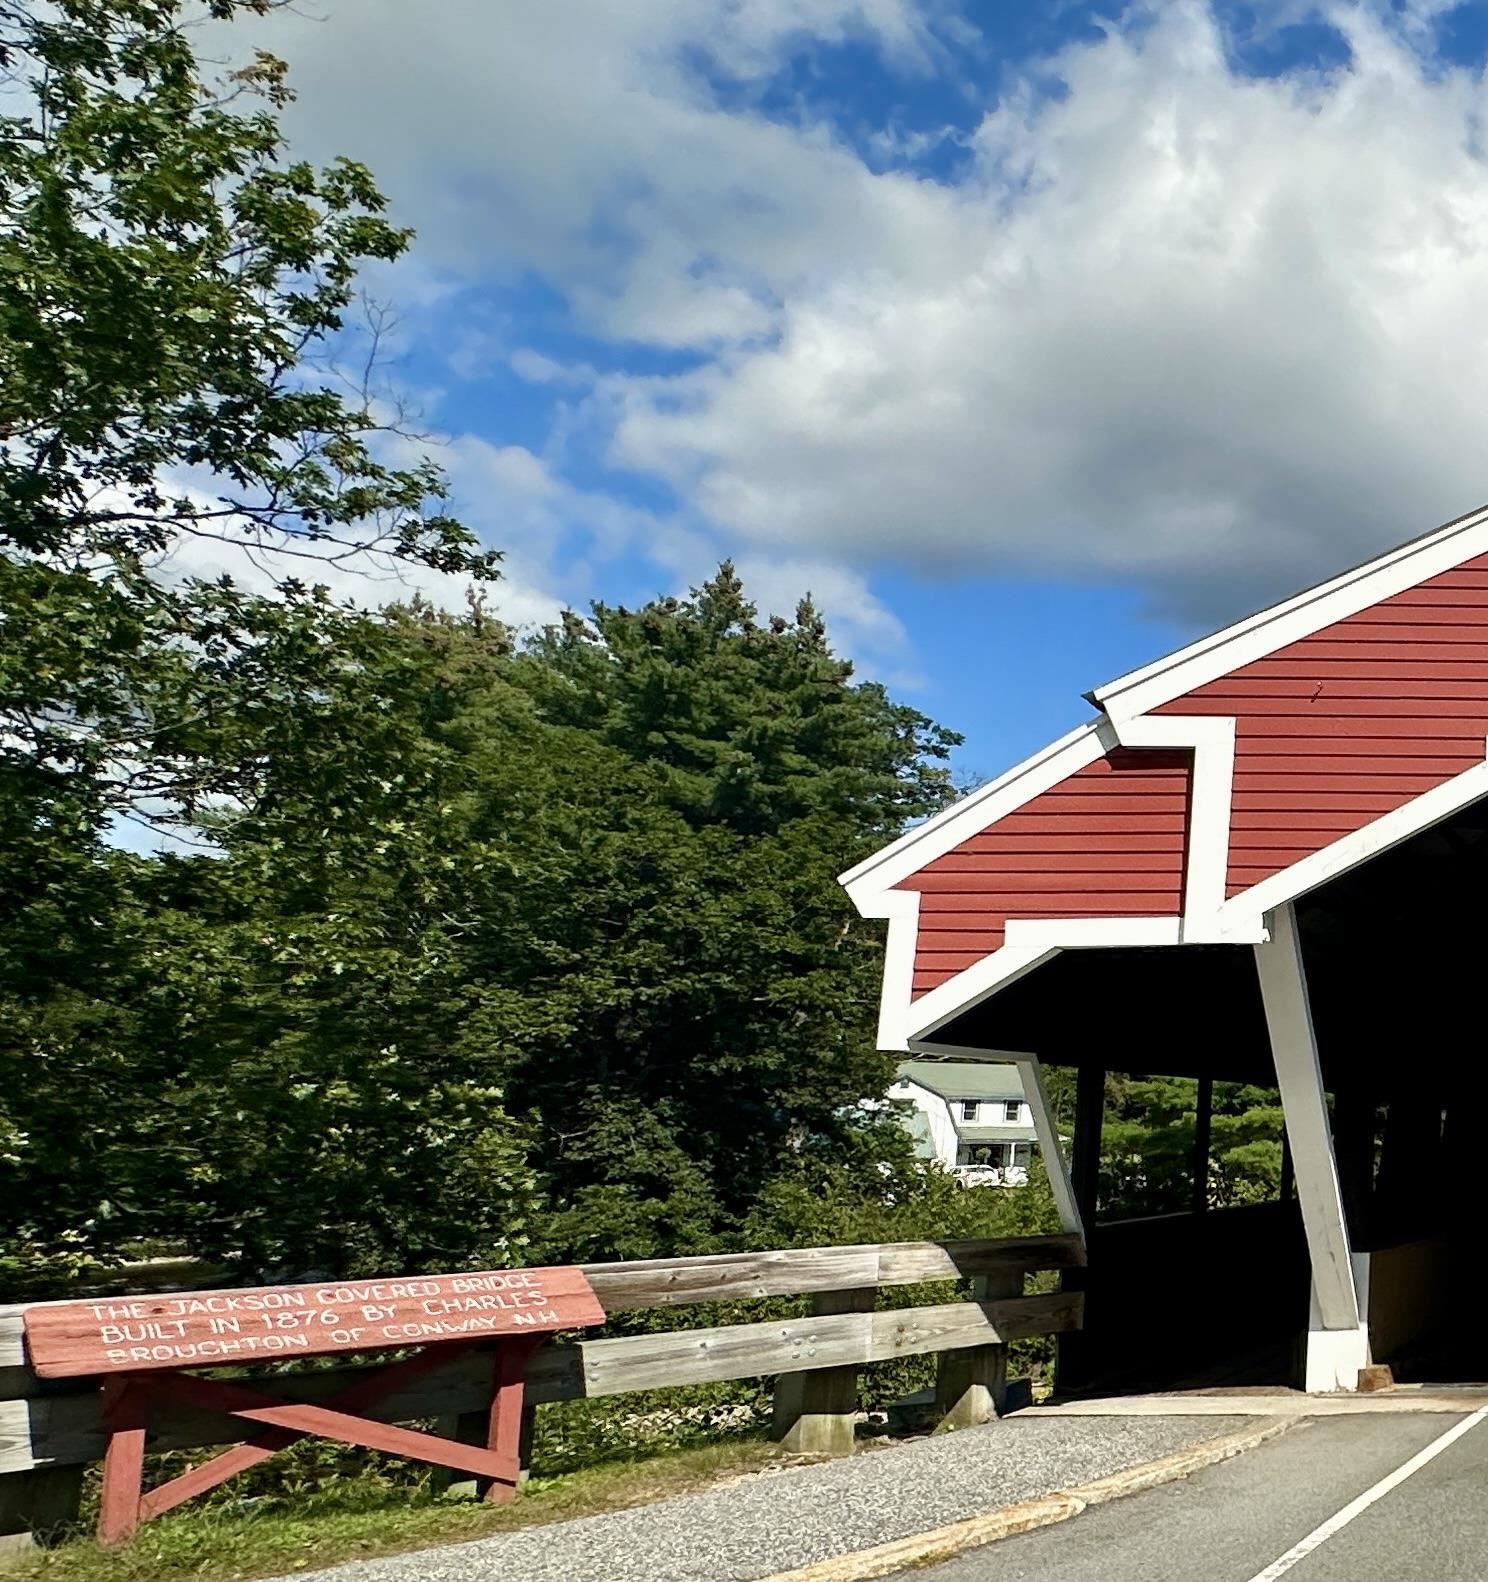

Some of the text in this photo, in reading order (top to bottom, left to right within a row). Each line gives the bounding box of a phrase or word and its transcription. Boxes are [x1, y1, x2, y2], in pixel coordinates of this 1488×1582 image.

[86, 1273, 543, 1321] THE JACKSON COVERED BRIDGE
[99, 1290, 548, 1344] BUILT IN 1876 BY CHARLES
[330, 1327, 366, 1344] OF
[382, 1315, 497, 1339] CONWAY
